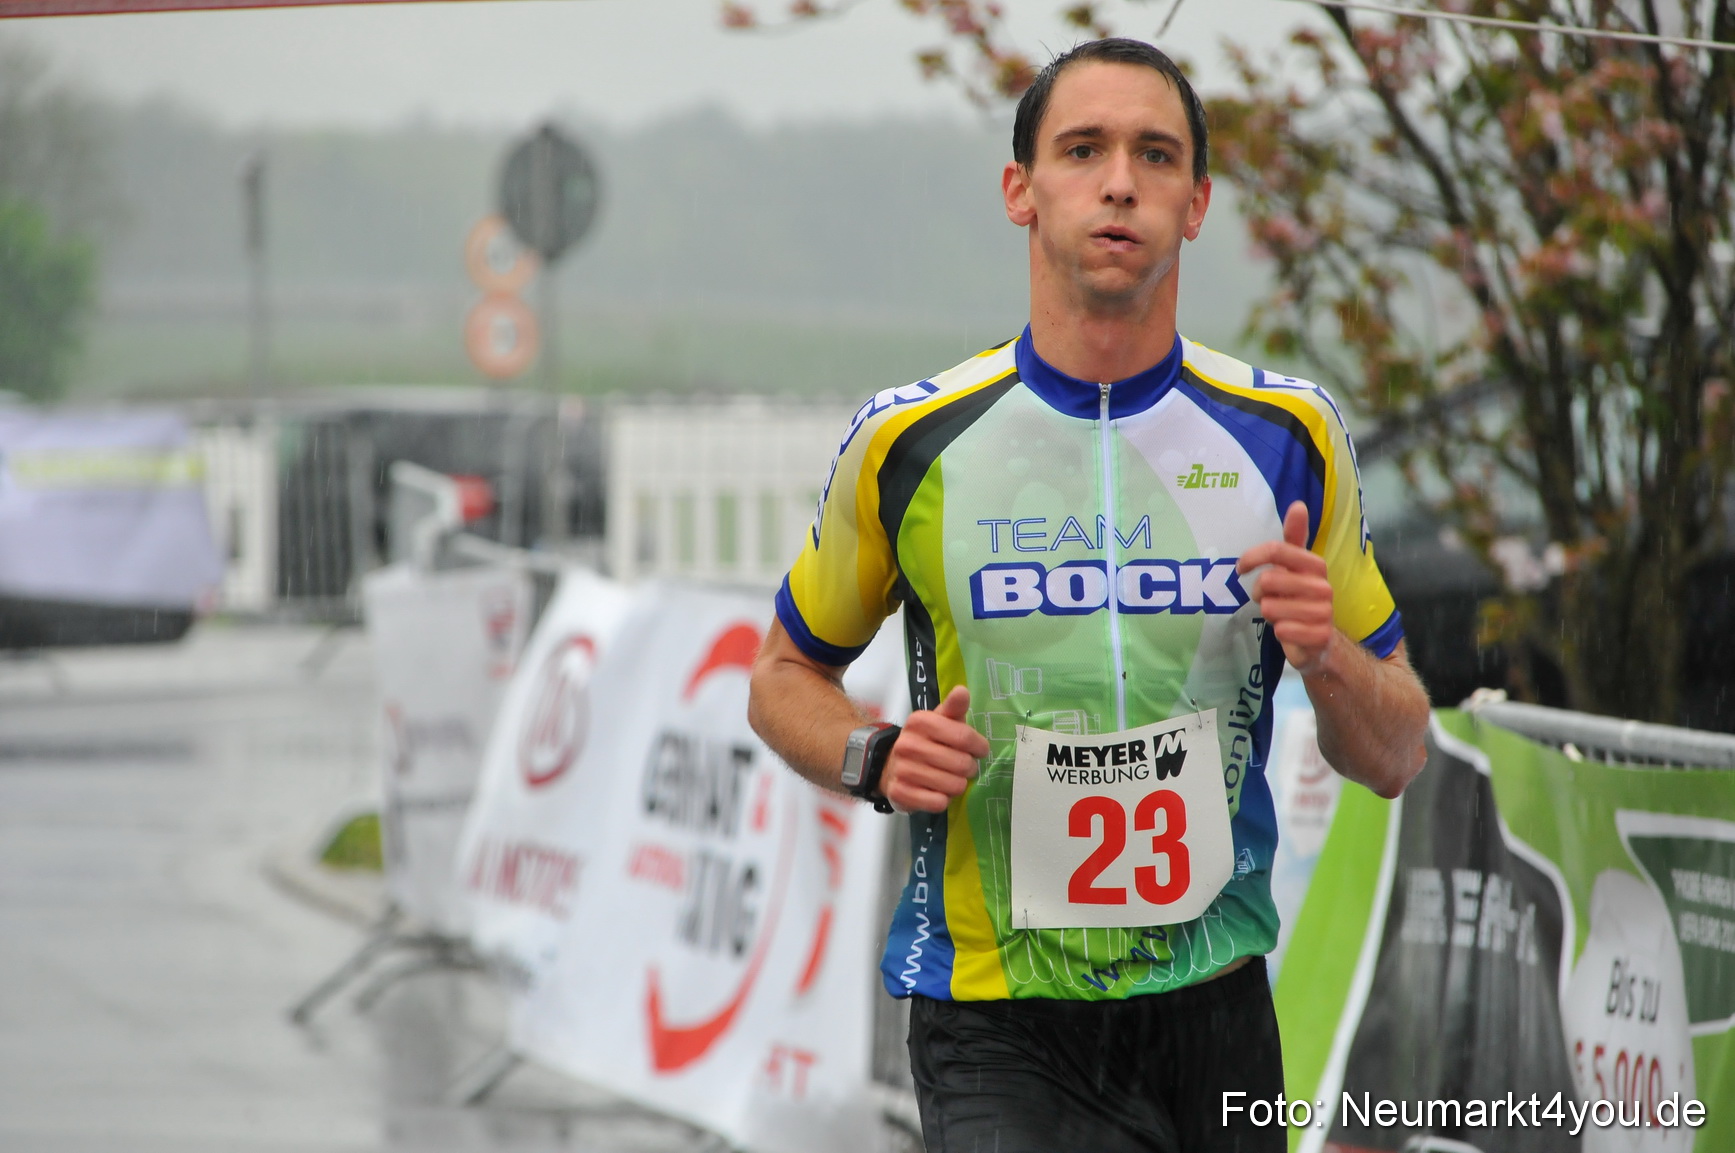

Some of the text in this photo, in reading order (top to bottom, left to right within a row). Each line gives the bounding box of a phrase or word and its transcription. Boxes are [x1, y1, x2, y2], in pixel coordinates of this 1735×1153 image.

[976, 513, 1152, 554] TEAM
[968, 557, 1252, 621] BOCK
[1045, 738, 1149, 769] MEYER
[1046, 763, 1150, 786] WERBUNG
[1067, 788, 1191, 906] 23
